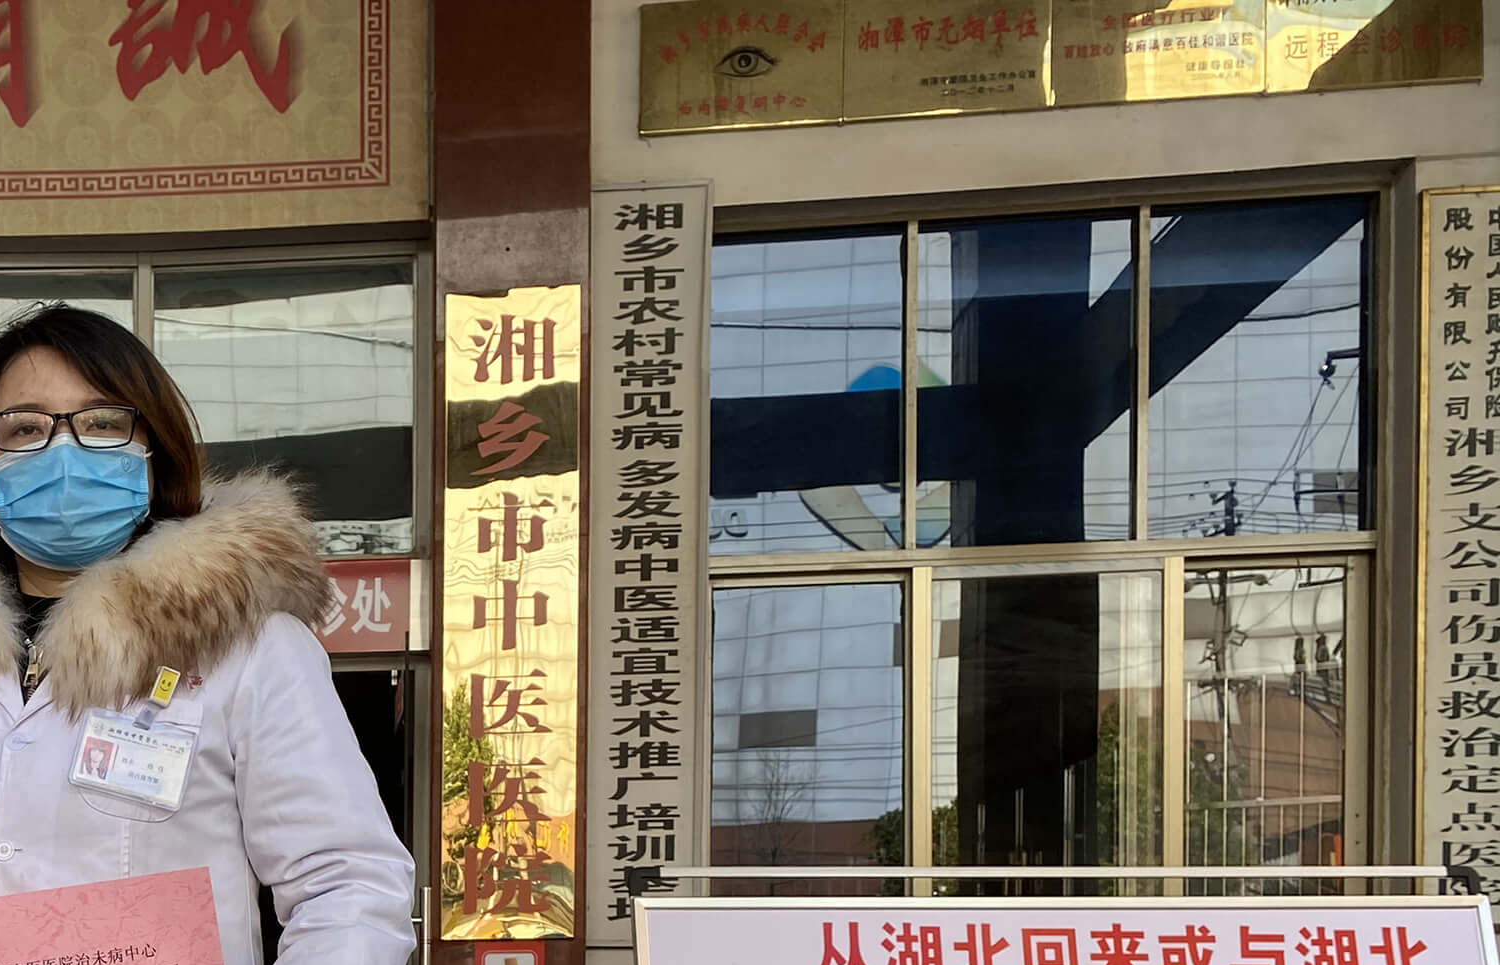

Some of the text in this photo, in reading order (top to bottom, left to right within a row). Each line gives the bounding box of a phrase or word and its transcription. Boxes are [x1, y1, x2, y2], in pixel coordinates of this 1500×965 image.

[1443, 207, 1475, 420] 股份有限公司
[463, 314, 557, 917] 湘乡市中医医院
